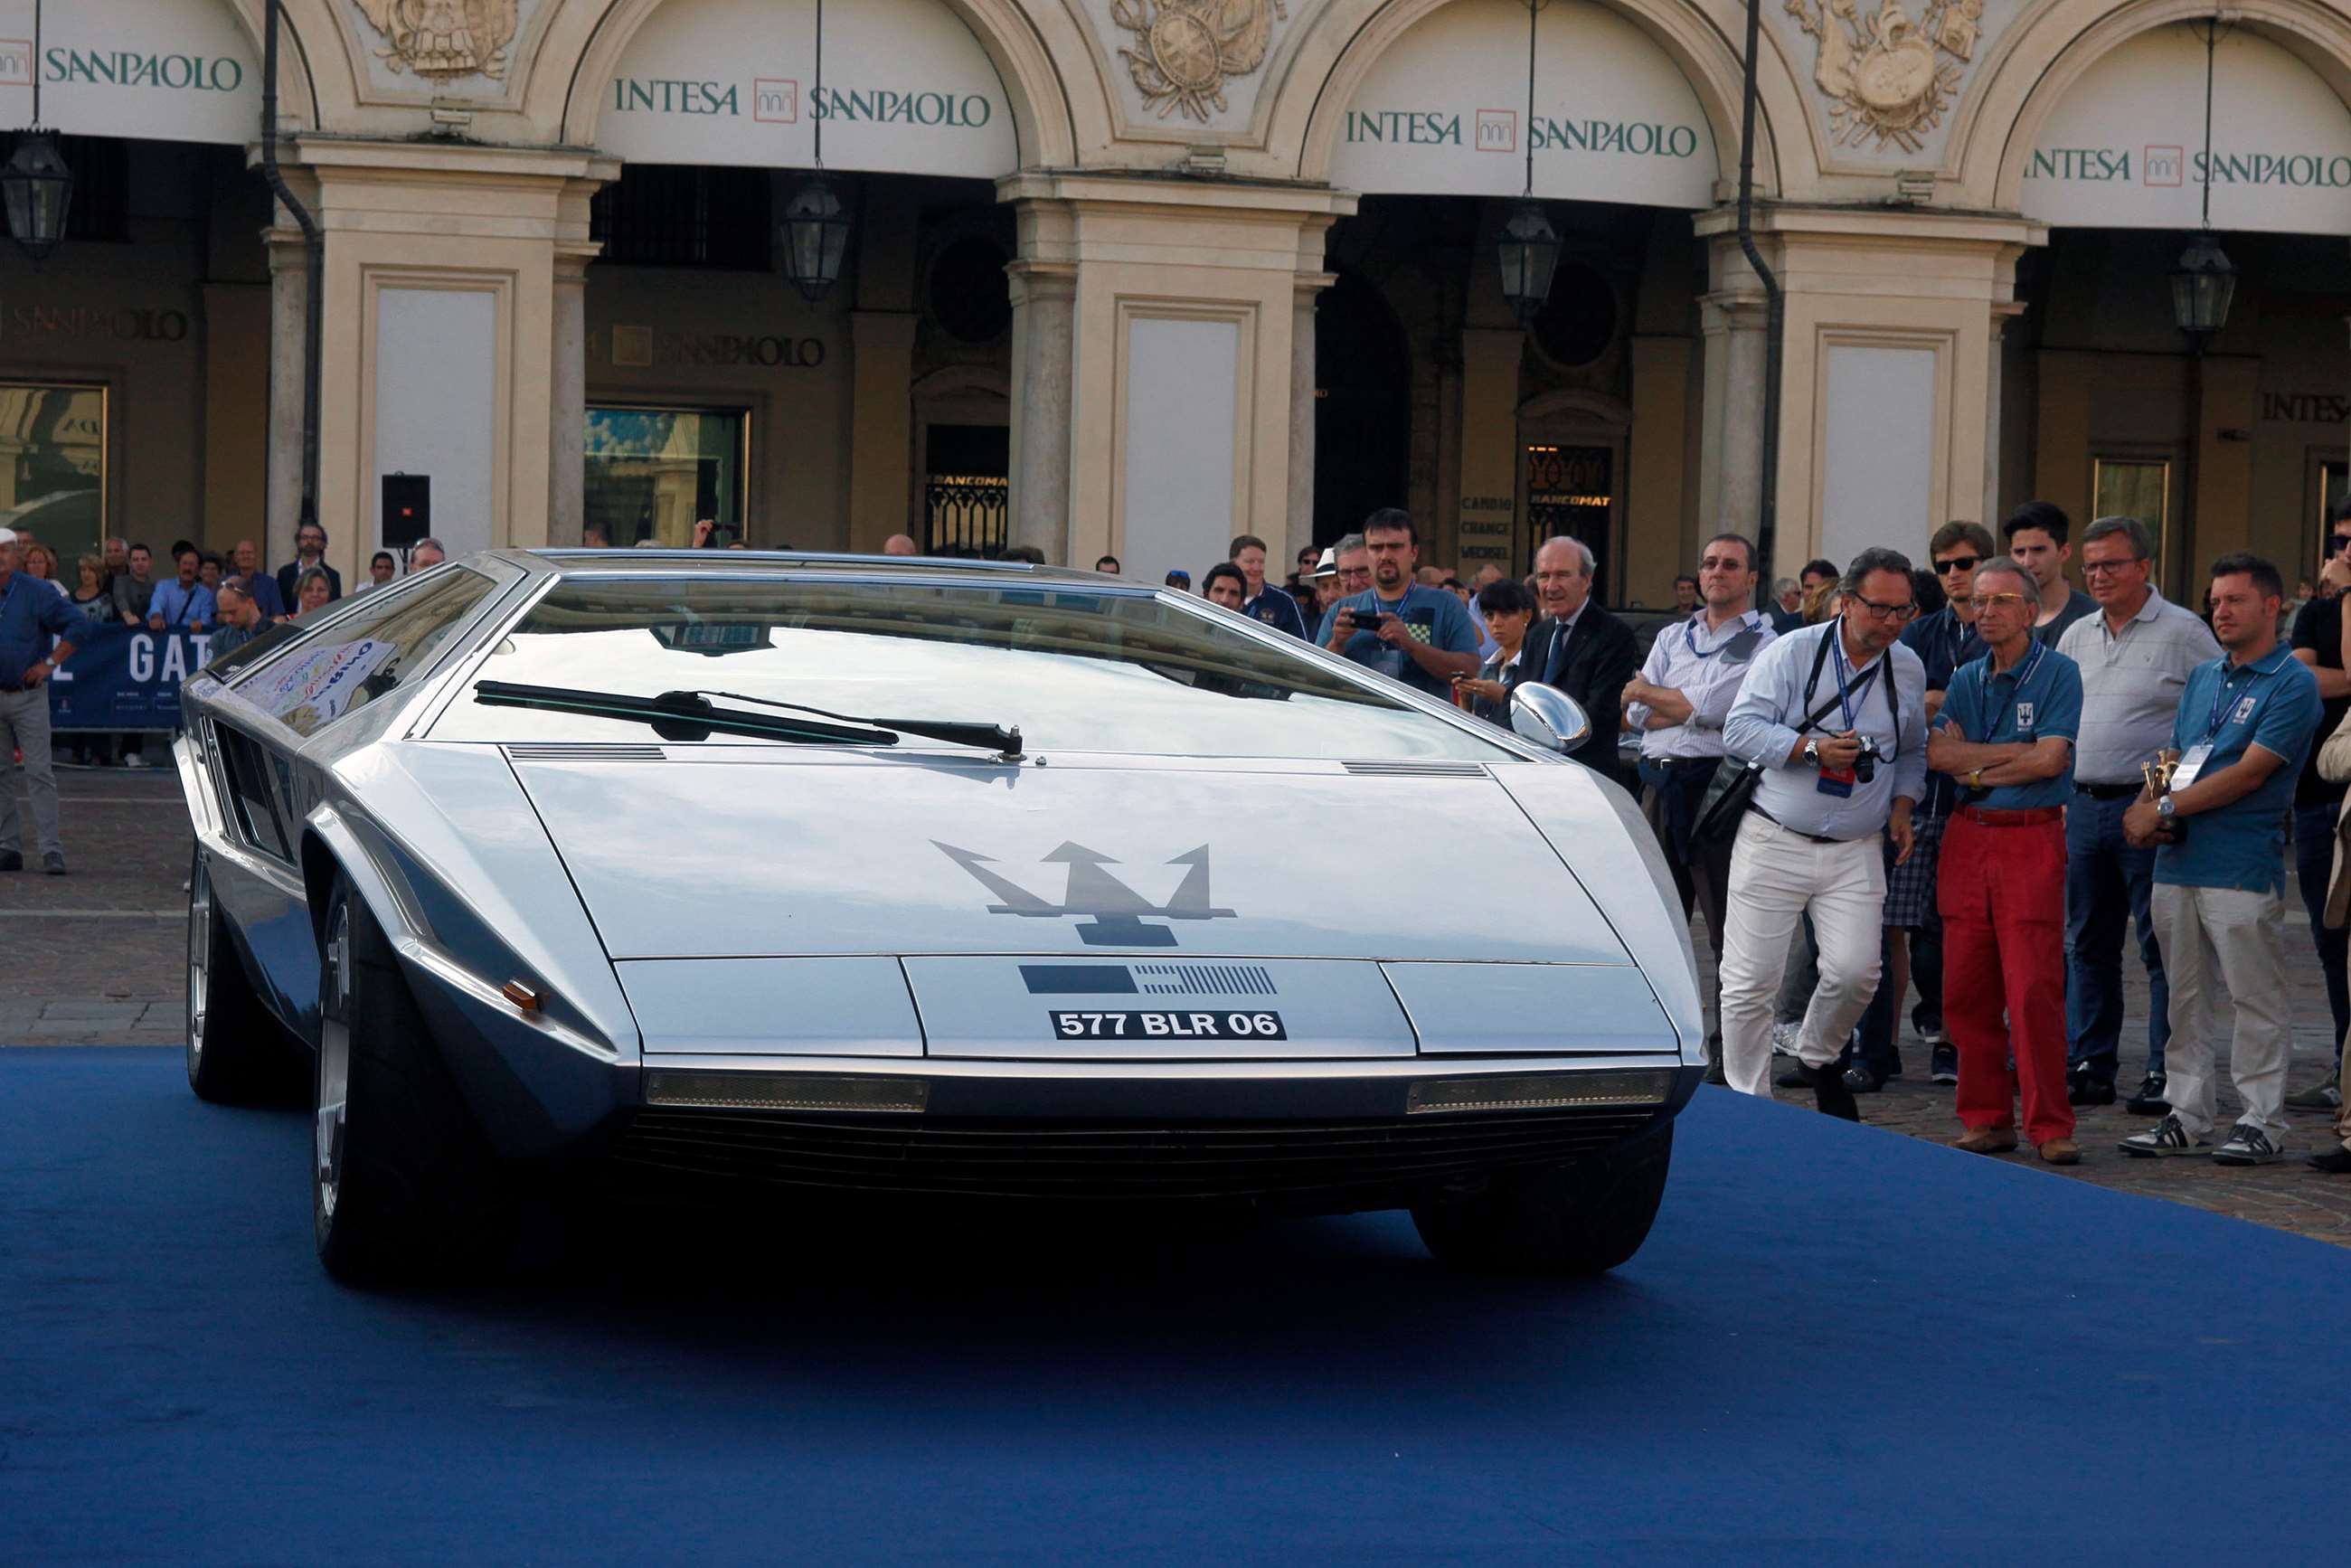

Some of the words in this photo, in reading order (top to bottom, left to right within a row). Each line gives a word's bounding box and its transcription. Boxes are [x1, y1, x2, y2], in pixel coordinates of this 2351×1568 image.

[45, 47, 242, 92] SANPAOLO
[614, 78, 741, 116] INTESA
[808, 87, 992, 128] SANPAOLO
[1345, 110, 1463, 145] INTESA
[1530, 117, 1697, 158] SANPAOLO
[2192, 150, 2351, 188] SANPAOLO
[2262, 392, 2350, 423] INTES
[932, 476, 1010, 486] BANCOMA
[1530, 496, 1611, 506] BANCOMAT
[1059, 1014, 1128, 1035] 577
[1140, 1014, 1219, 1035] BLR
[1227, 1014, 1279, 1035] 06
